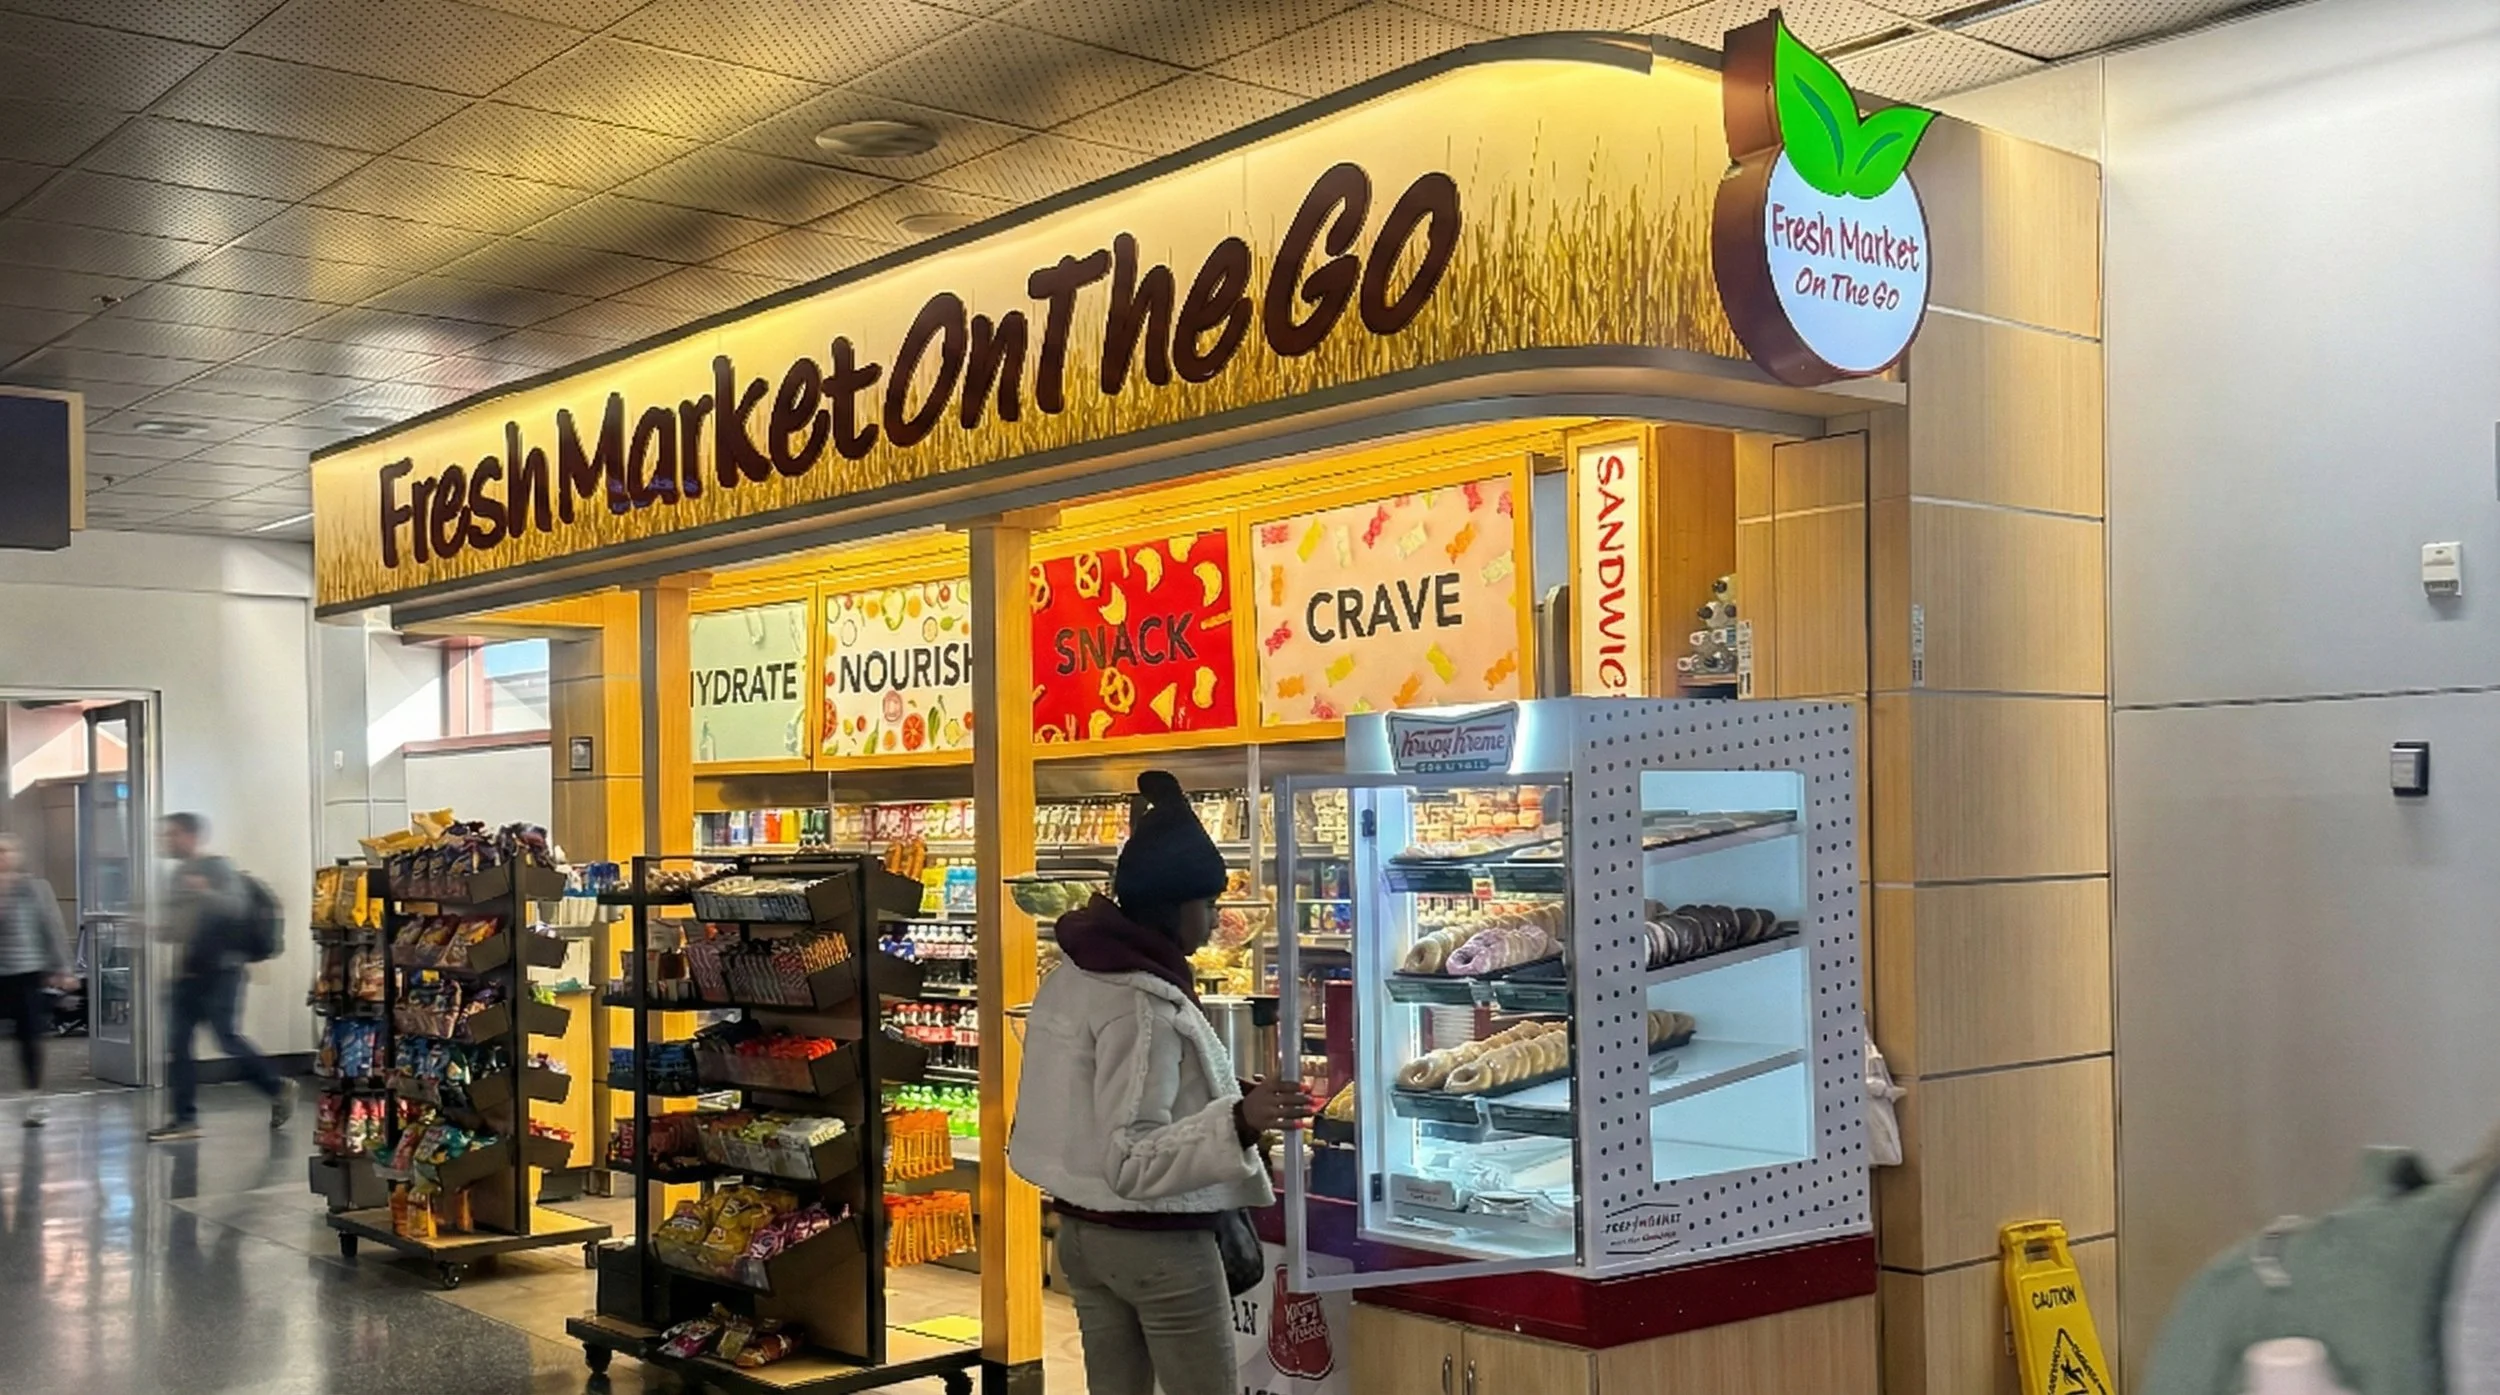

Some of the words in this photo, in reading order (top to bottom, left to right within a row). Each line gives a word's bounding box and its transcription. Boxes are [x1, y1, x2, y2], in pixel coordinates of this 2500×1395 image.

[1771, 203, 1834, 258] Fresh
[1840, 217, 1920, 272] Market
[1796, 267, 1827, 298] On
[1832, 273, 1869, 306] The
[380, 421, 552, 569] Fresh
[557, 336, 882, 514] Market
[884, 292, 1028, 448] On
[1028, 232, 1253, 414] The
[1306, 572, 1463, 643] CRAVE
[1597, 455, 1627, 697] SANDWIC
[1056, 613, 1197, 674] SNACK
[690, 661, 797, 708] YDRATE
[2032, 1285, 2077, 1310] CAUTION
